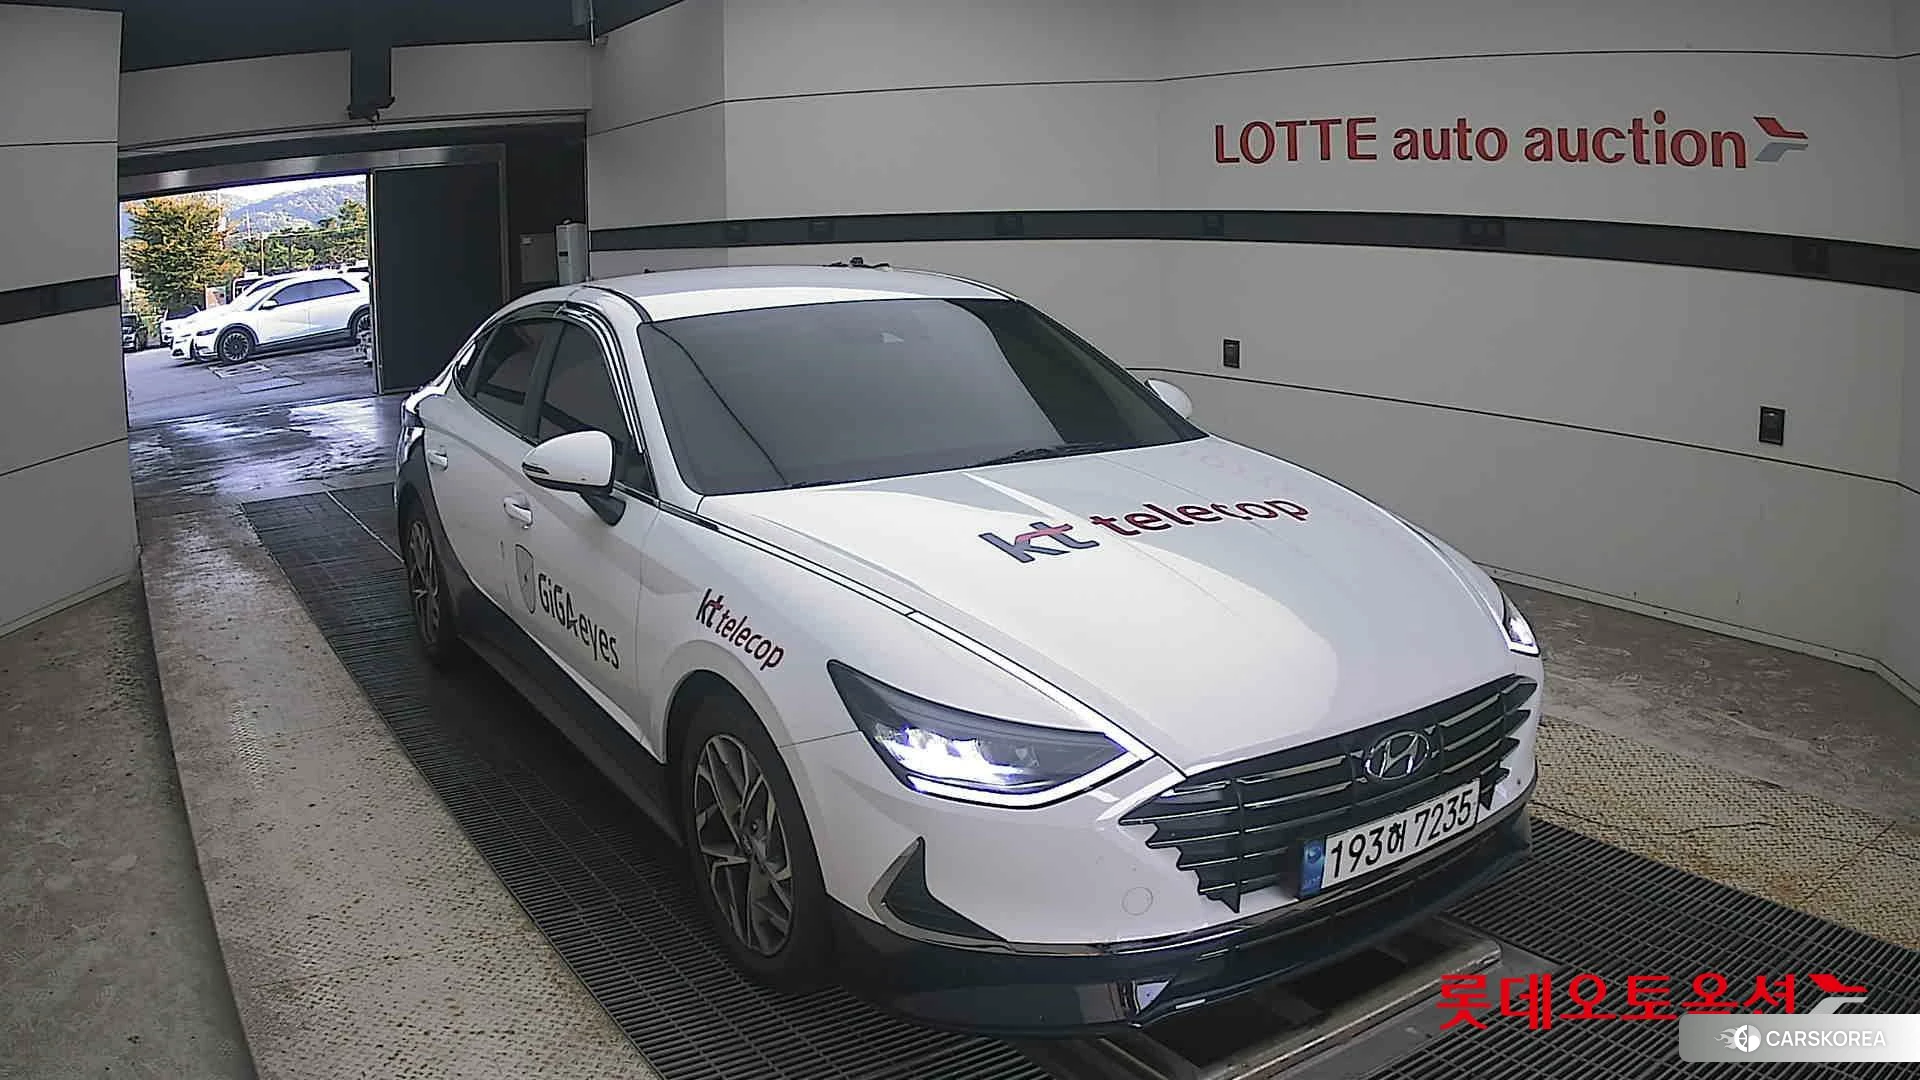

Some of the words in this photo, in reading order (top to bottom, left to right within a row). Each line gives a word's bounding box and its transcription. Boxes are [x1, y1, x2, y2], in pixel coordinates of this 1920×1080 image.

[1214, 117, 1377, 164] LOTTE
[1393, 118, 1508, 162] auto
[1524, 110, 1746, 168] auction
[978, 522, 1100, 564] kt
[1090, 499, 1310, 537] telecop
[695, 588, 723, 628] kt
[714, 608, 786, 671] telecop
[1331, 820, 1408, 879] 193허
[1414, 789, 1474, 848] 7235
